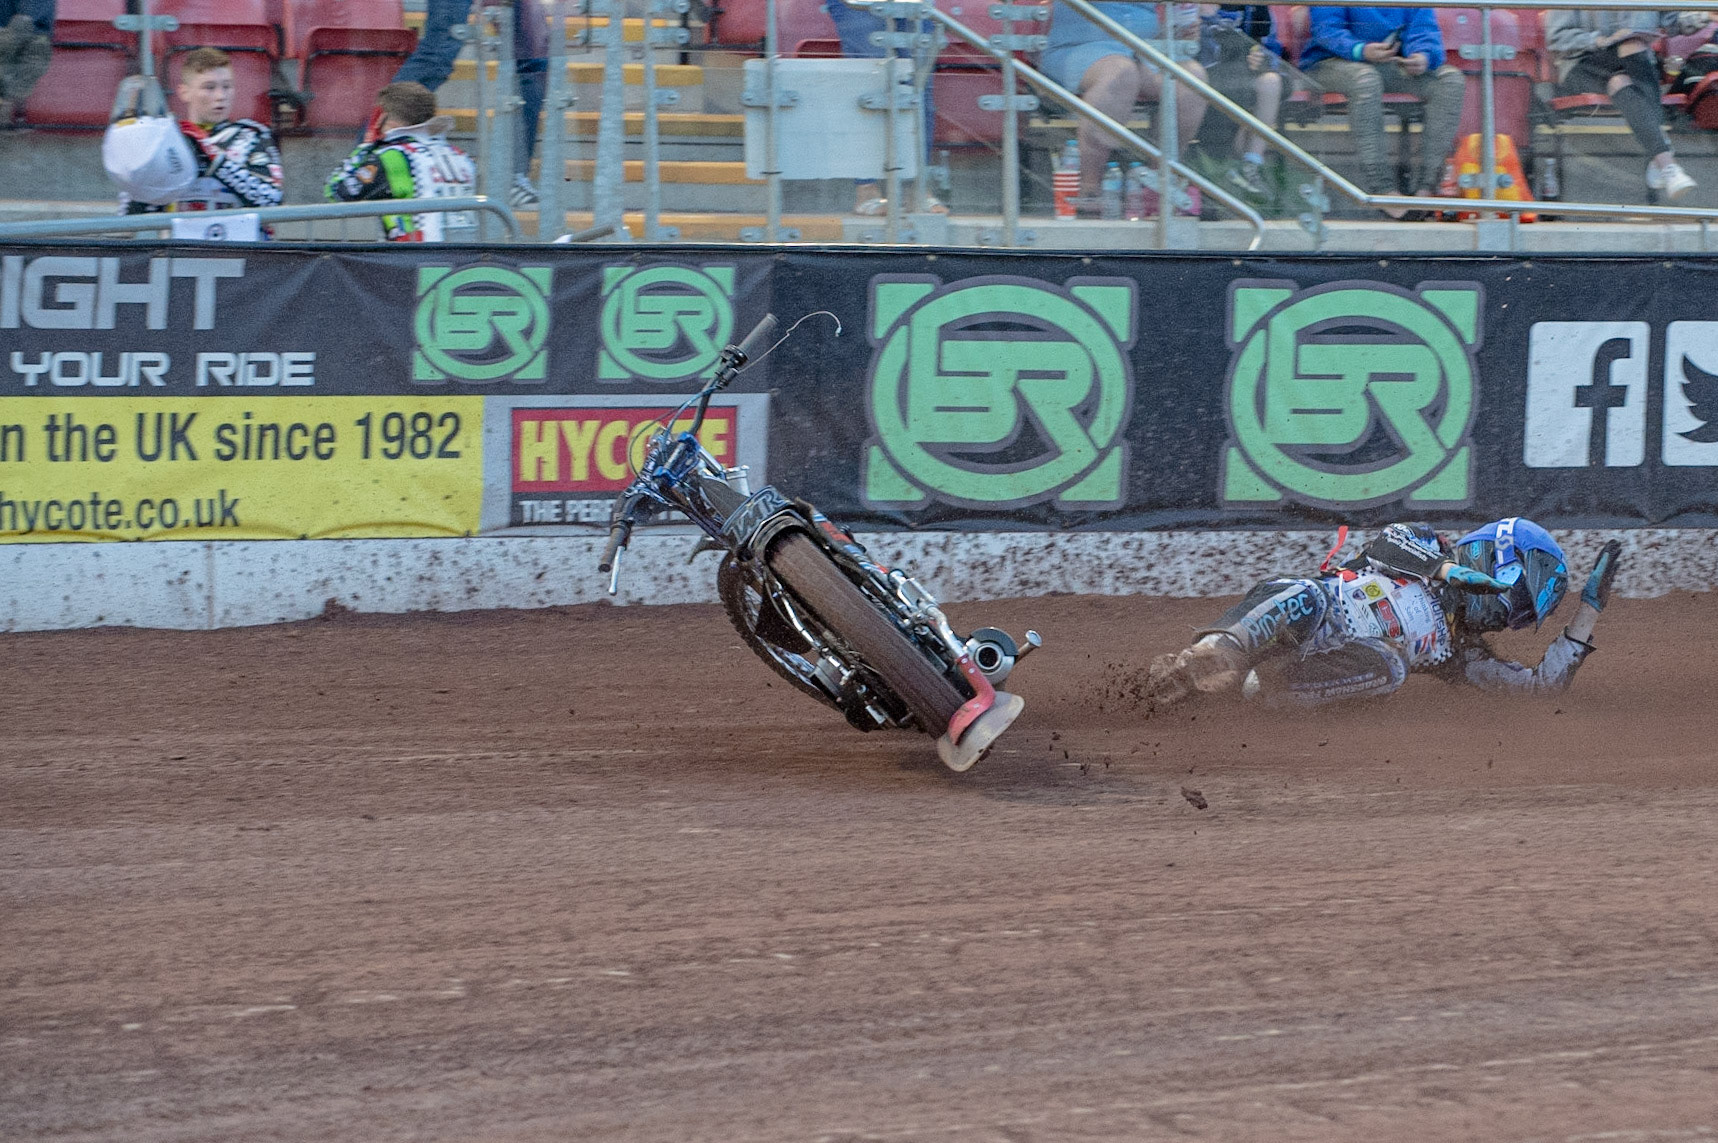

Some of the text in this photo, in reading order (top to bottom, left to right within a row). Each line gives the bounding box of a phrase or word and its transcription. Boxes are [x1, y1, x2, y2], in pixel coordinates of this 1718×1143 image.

[10, 351, 316, 387] YOUR RIDE
[43, 412, 118, 462] the
[135, 412, 199, 462] UK
[214, 411, 336, 461] since
[355, 411, 462, 460] 1982
[519, 500, 562, 523] THE
